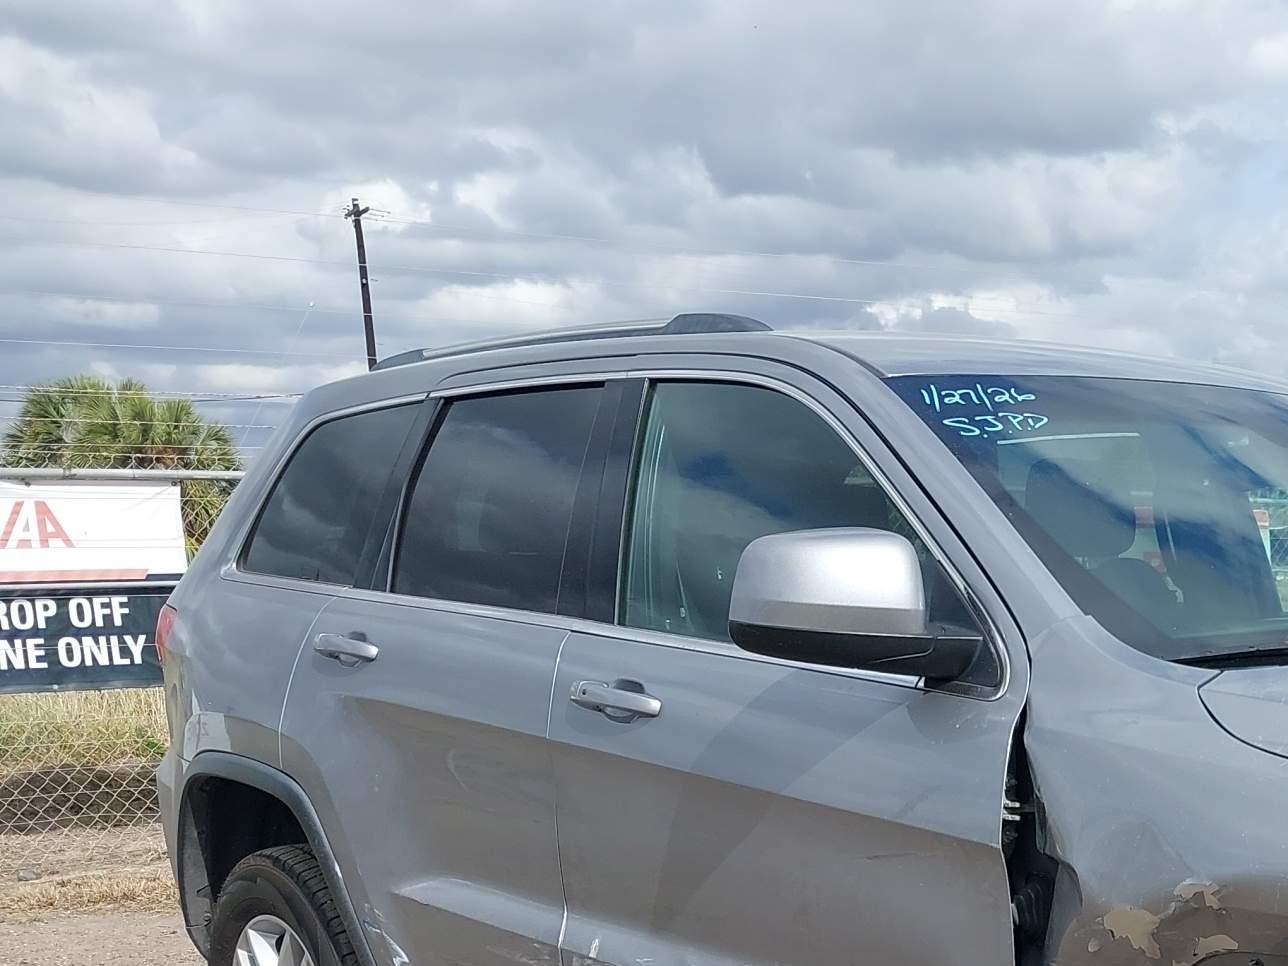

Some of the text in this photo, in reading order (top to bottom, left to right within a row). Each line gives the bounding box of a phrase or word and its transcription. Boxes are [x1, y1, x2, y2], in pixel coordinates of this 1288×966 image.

[920, 383, 1037, 412] 1/27/26
[68, 596, 130, 629] OFF
[57, 634, 147, 668] ONLY
